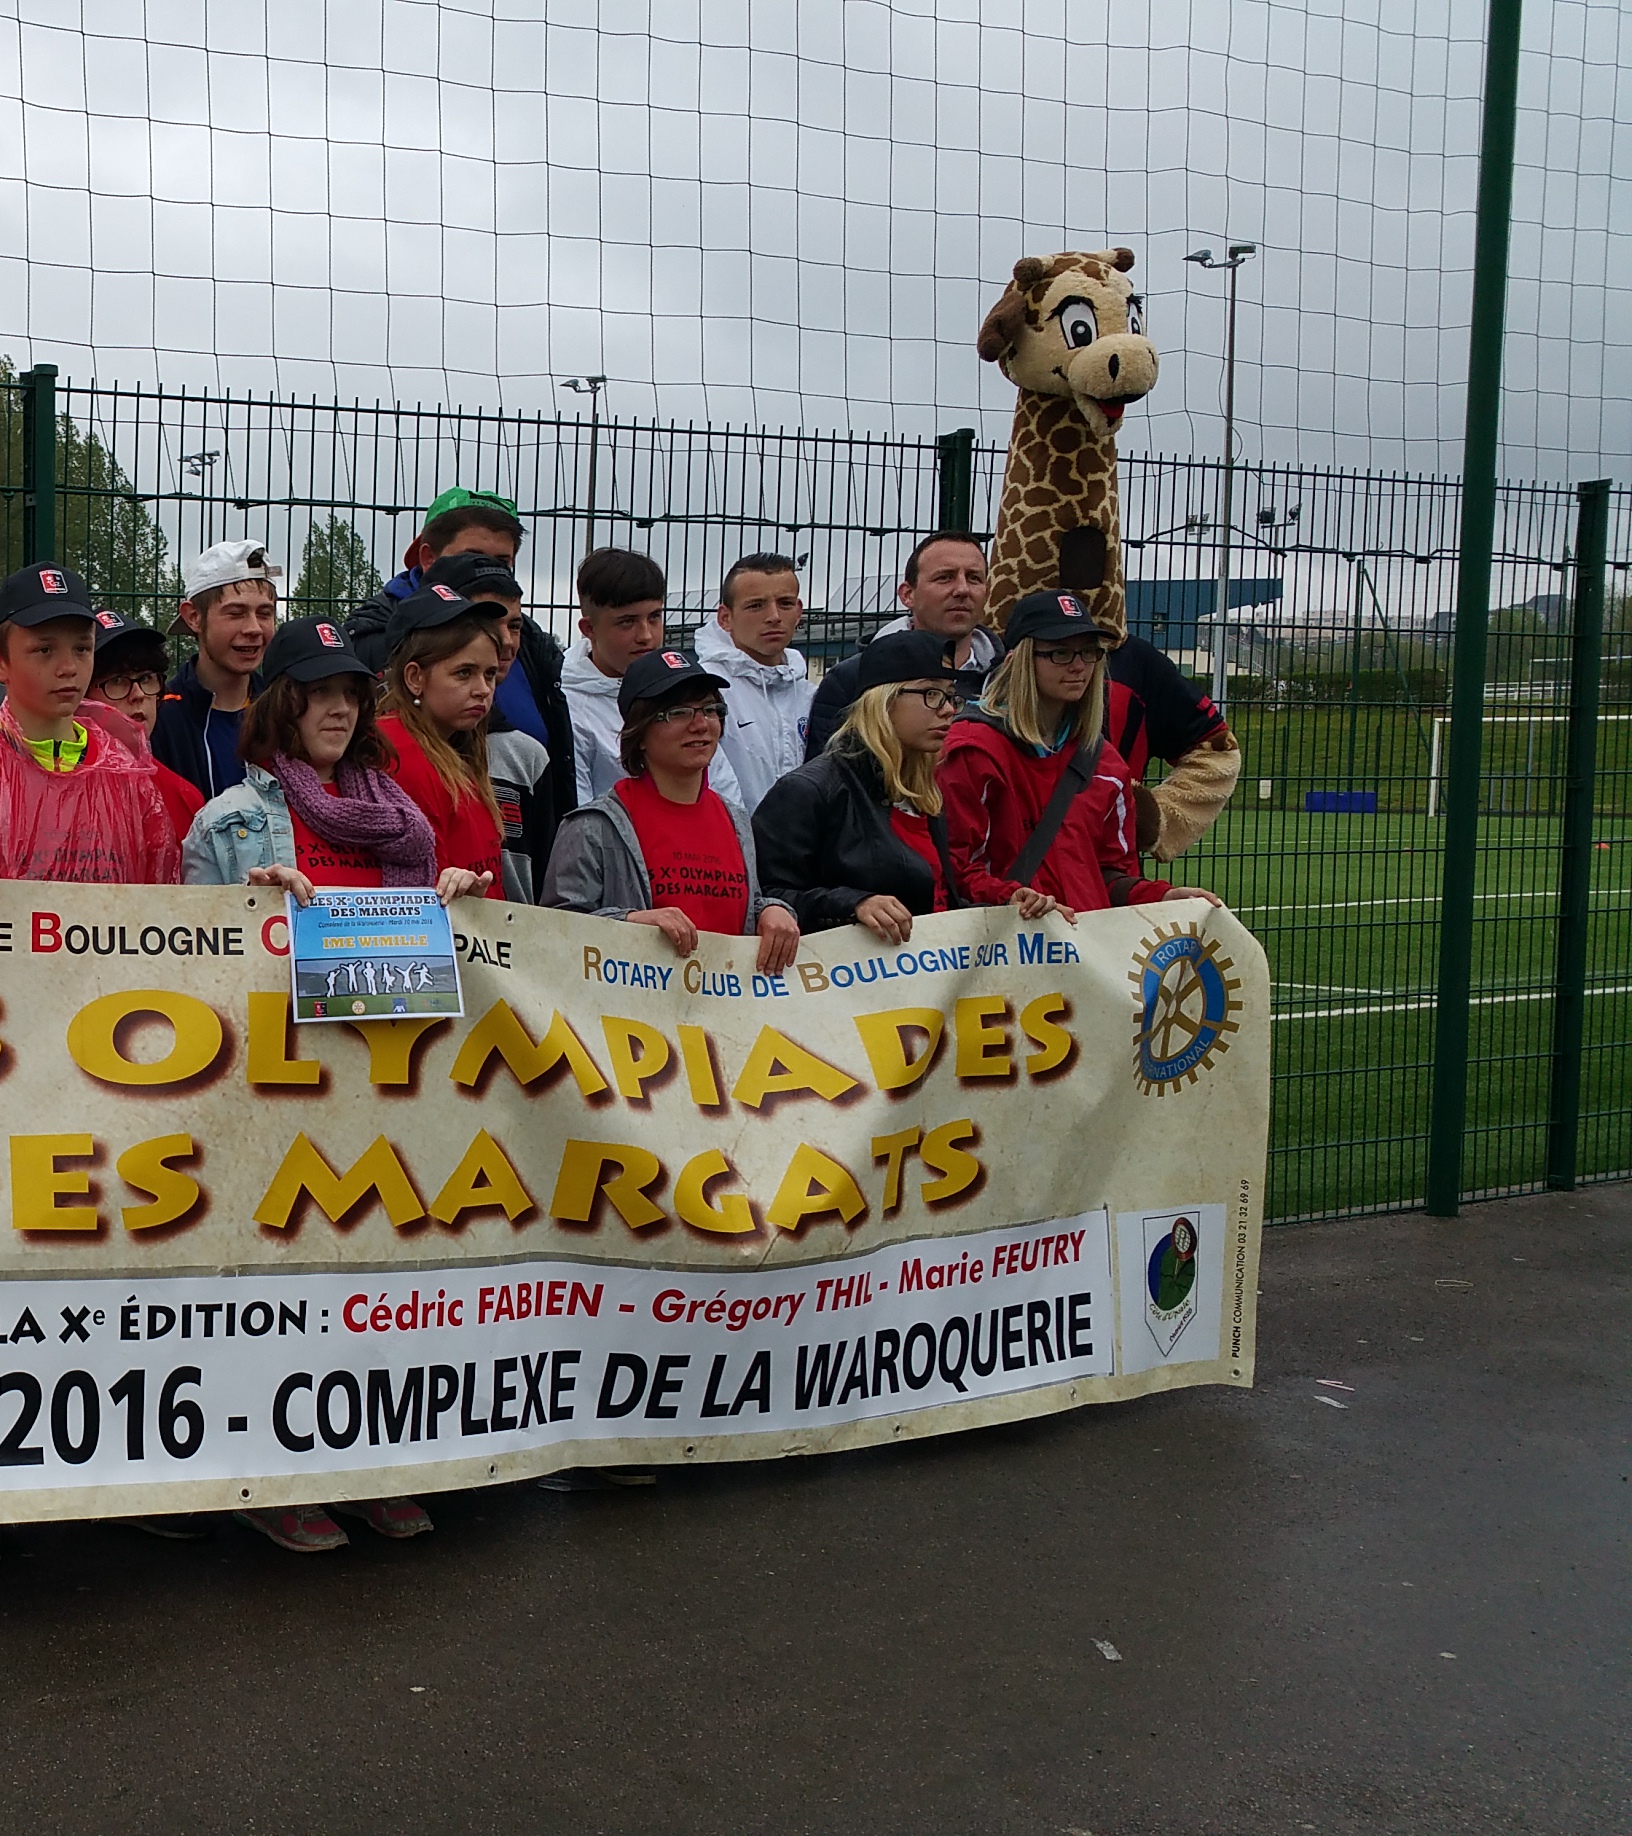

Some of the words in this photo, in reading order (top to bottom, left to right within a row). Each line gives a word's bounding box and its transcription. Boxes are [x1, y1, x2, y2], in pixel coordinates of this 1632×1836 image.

[679, 866, 748, 884] OLYMPIAD
[655, 882, 681, 896] DES
[683, 882, 743, 899] MARGATS
[310, 895, 333, 907] LES
[355, 894, 437, 907] OLYMPIADES
[330, 907, 356, 918] DES
[358, 906, 421, 917] MARGATS
[323, 937, 355, 949] IME
[358, 935, 428, 948] WIMILLE
[1156, 940, 1199, 966] ROTAR
[67, 990, 1072, 1109] OLYMPIADES
[253, 1118, 981, 1233] MARGATS
[1241, 1179, 1250, 1190] 69
[1240, 1192, 1249, 1204] 69
[1239, 1206, 1248, 1217] 32
[1239, 1220, 1248, 1230] 21
[1238, 1232, 1247, 1243] 03
[119, 1294, 307, 1343] ÉDITION
[343, 1286, 463, 1333] Cédric
[477, 1280, 604, 1325] FABIEN
[652, 1284, 805, 1331] Grégory
[815, 1271, 873, 1315] THIL
[898, 1253, 984, 1295] Marie
[990, 1230, 1086, 1281] FEUTRY
[1233, 1245, 1246, 1323] COMMUNICATION
[1232, 1326, 1242, 1358] PUNCH
[272, 1350, 582, 1453] COMPLEXE
[596, 1352, 690, 1420] DE
[700, 1350, 771, 1418] LA
[794, 1292, 1093, 1411] WAROQUERIE
